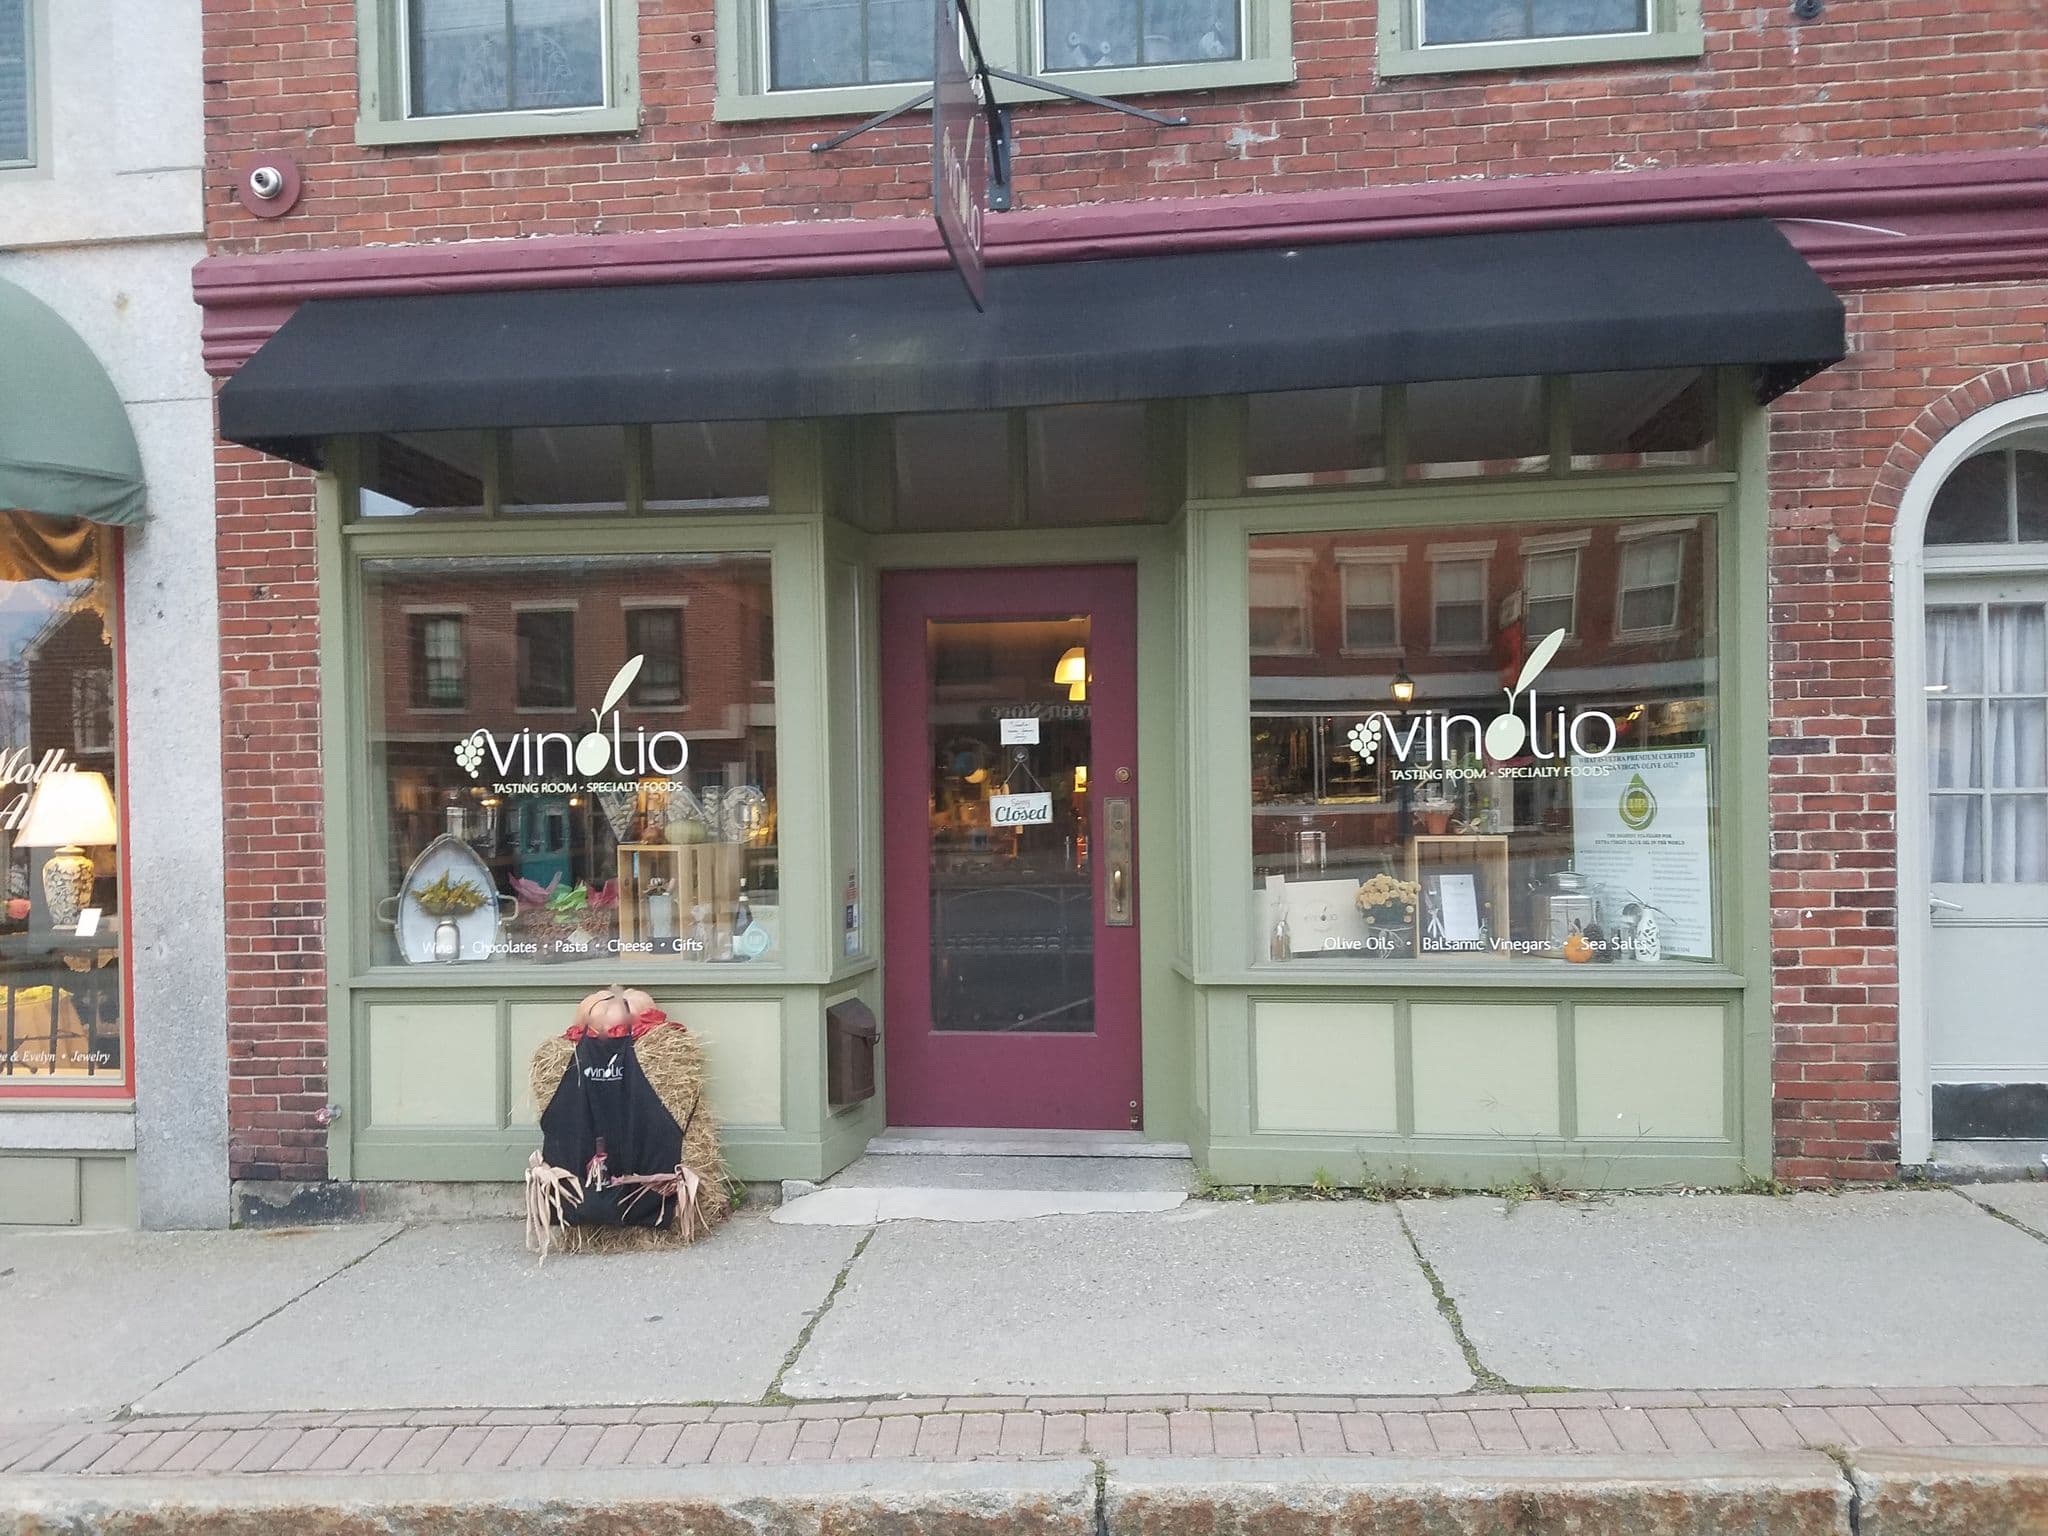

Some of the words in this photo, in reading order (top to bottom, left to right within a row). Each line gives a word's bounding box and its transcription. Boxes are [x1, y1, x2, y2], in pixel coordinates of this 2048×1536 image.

[1384, 689, 1617, 763] vinolio
[487, 710, 689, 777] vinolio
[1627, 753, 1659, 762] PREMIUM
[1390, 770, 1443, 781] TASTING
[1446, 769, 1486, 780] ROOM
[1499, 766, 1561, 778] SPECIALTY
[1564, 766, 1609, 777] FOODS
[1618, 762, 1642, 770] VIRGIN
[492, 783, 539, 794] TASTING
[541, 782, 577, 793] ROOM
[586, 781, 640, 793] SPECIALTY
[642, 781, 683, 793] FOODS
[995, 804, 1048, 823] Closed
[472, 940, 537, 954] Chocolates
[555, 940, 588, 954] Pasta
[607, 938, 654, 953] Cheese
[672, 938, 704, 953] Gifts
[1324, 936, 1361, 950] Olive
[1366, 936, 1395, 950] Oils
[1423, 936, 1485, 950] Balsamic
[1489, 937, 1552, 954] Vinegars
[1580, 936, 1607, 951] Sea
[22, 1050, 56, 1063] Evelyn
[70, 1050, 111, 1065] Jewelry
